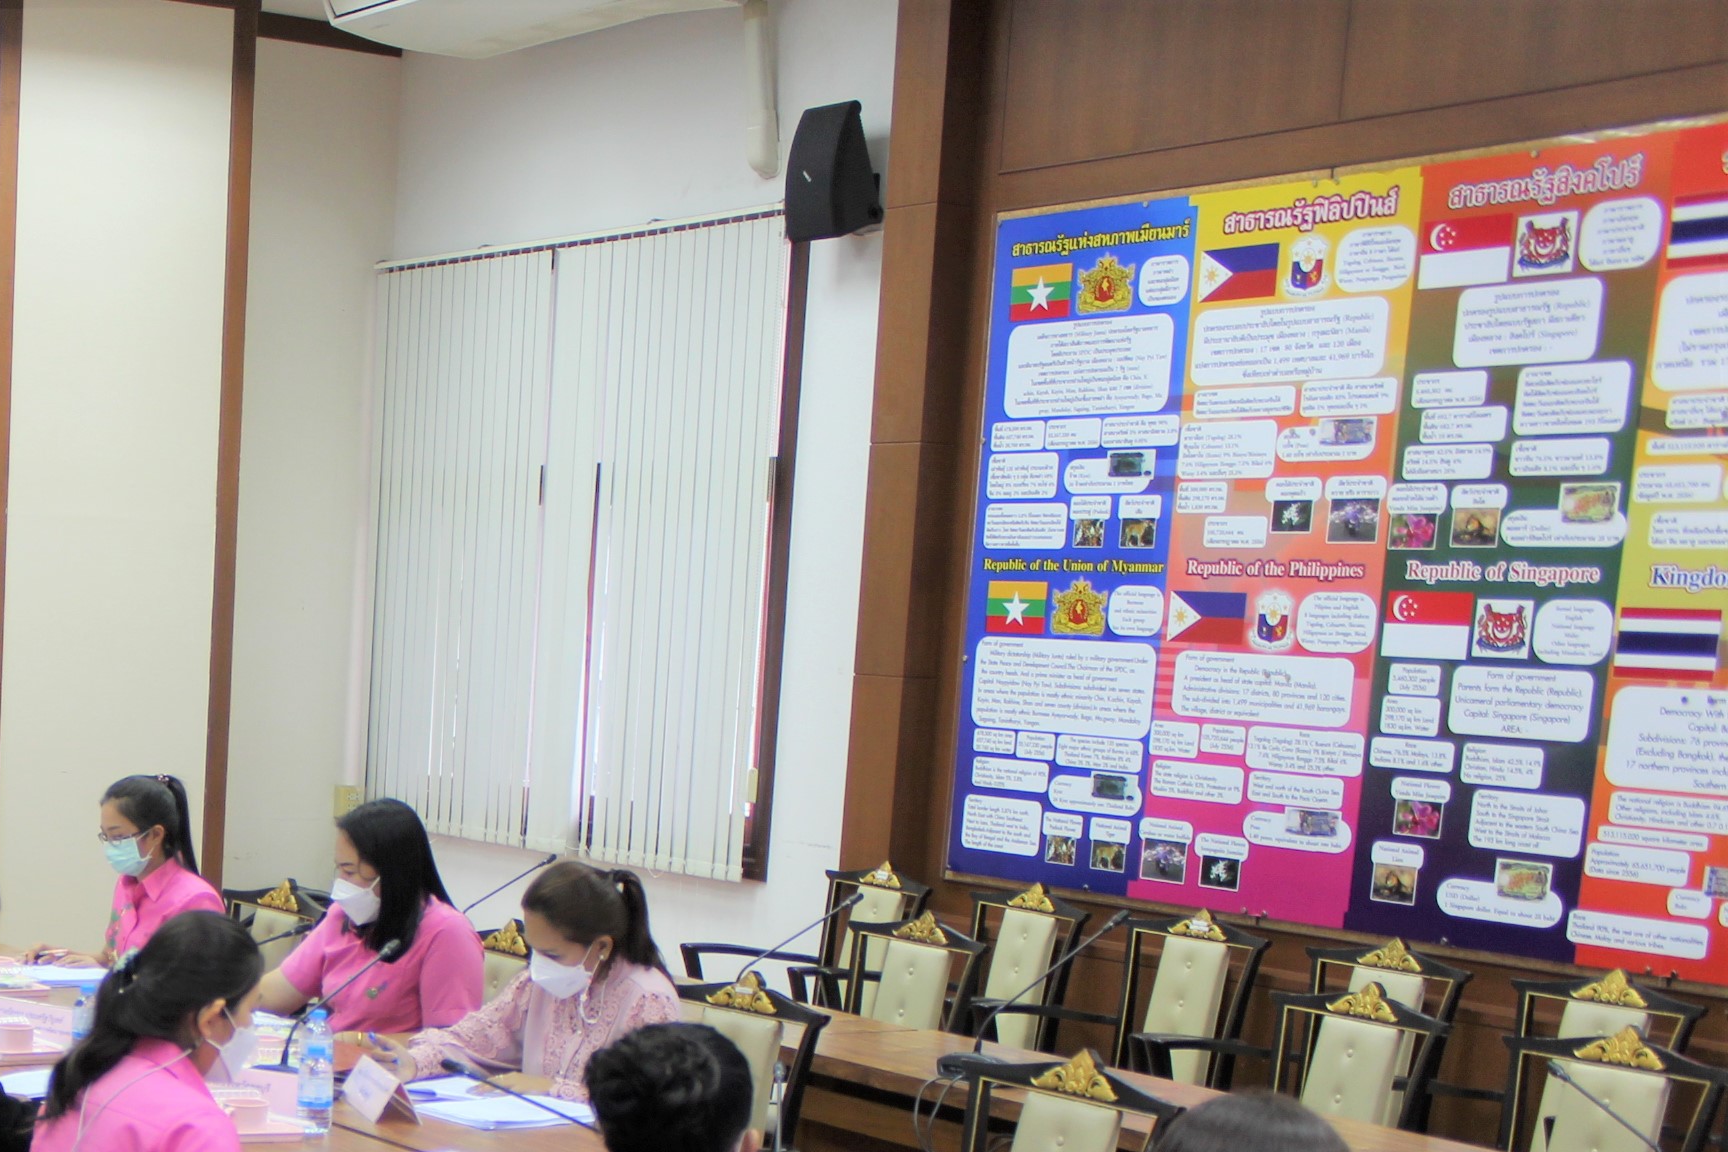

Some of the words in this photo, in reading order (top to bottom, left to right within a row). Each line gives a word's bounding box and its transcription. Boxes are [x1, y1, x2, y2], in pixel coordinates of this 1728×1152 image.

[1447, 153, 1641, 209] สาธารณรัฐสิงคโปร์
[1223, 184, 1399, 237] สาธารณรัฐฟิลิปปินส์
[1011, 218, 1191, 256] สาธารณรัฐแห่งสหภาพเมียนมาร์
[983, 558, 1027, 574] Republic
[1030, 559, 1041, 571] of
[1043, 559, 1060, 572] the
[1063, 559, 1094, 573] Union
[1097, 560, 1110, 573] of
[1112, 560, 1164, 575] Myanmar
[1187, 559, 1242, 578] Republic
[1246, 560, 1261, 576] of
[1263, 560, 1285, 577] the
[1289, 561, 1364, 581] Philippines
[1406, 560, 1480, 584] Republic
[1486, 561, 1505, 581] of
[1508, 561, 1600, 587] Singapore
[1649, 564, 1728, 592] Kingdo
[1486, 670, 1504, 679] Form
[1505, 671, 1514, 679] of
[1514, 674, 1556, 683] government
[1454, 696, 1493, 705] Unicameral
[1494, 698, 1542, 708] parliamentary
[1544, 702, 1583, 710] democracy
